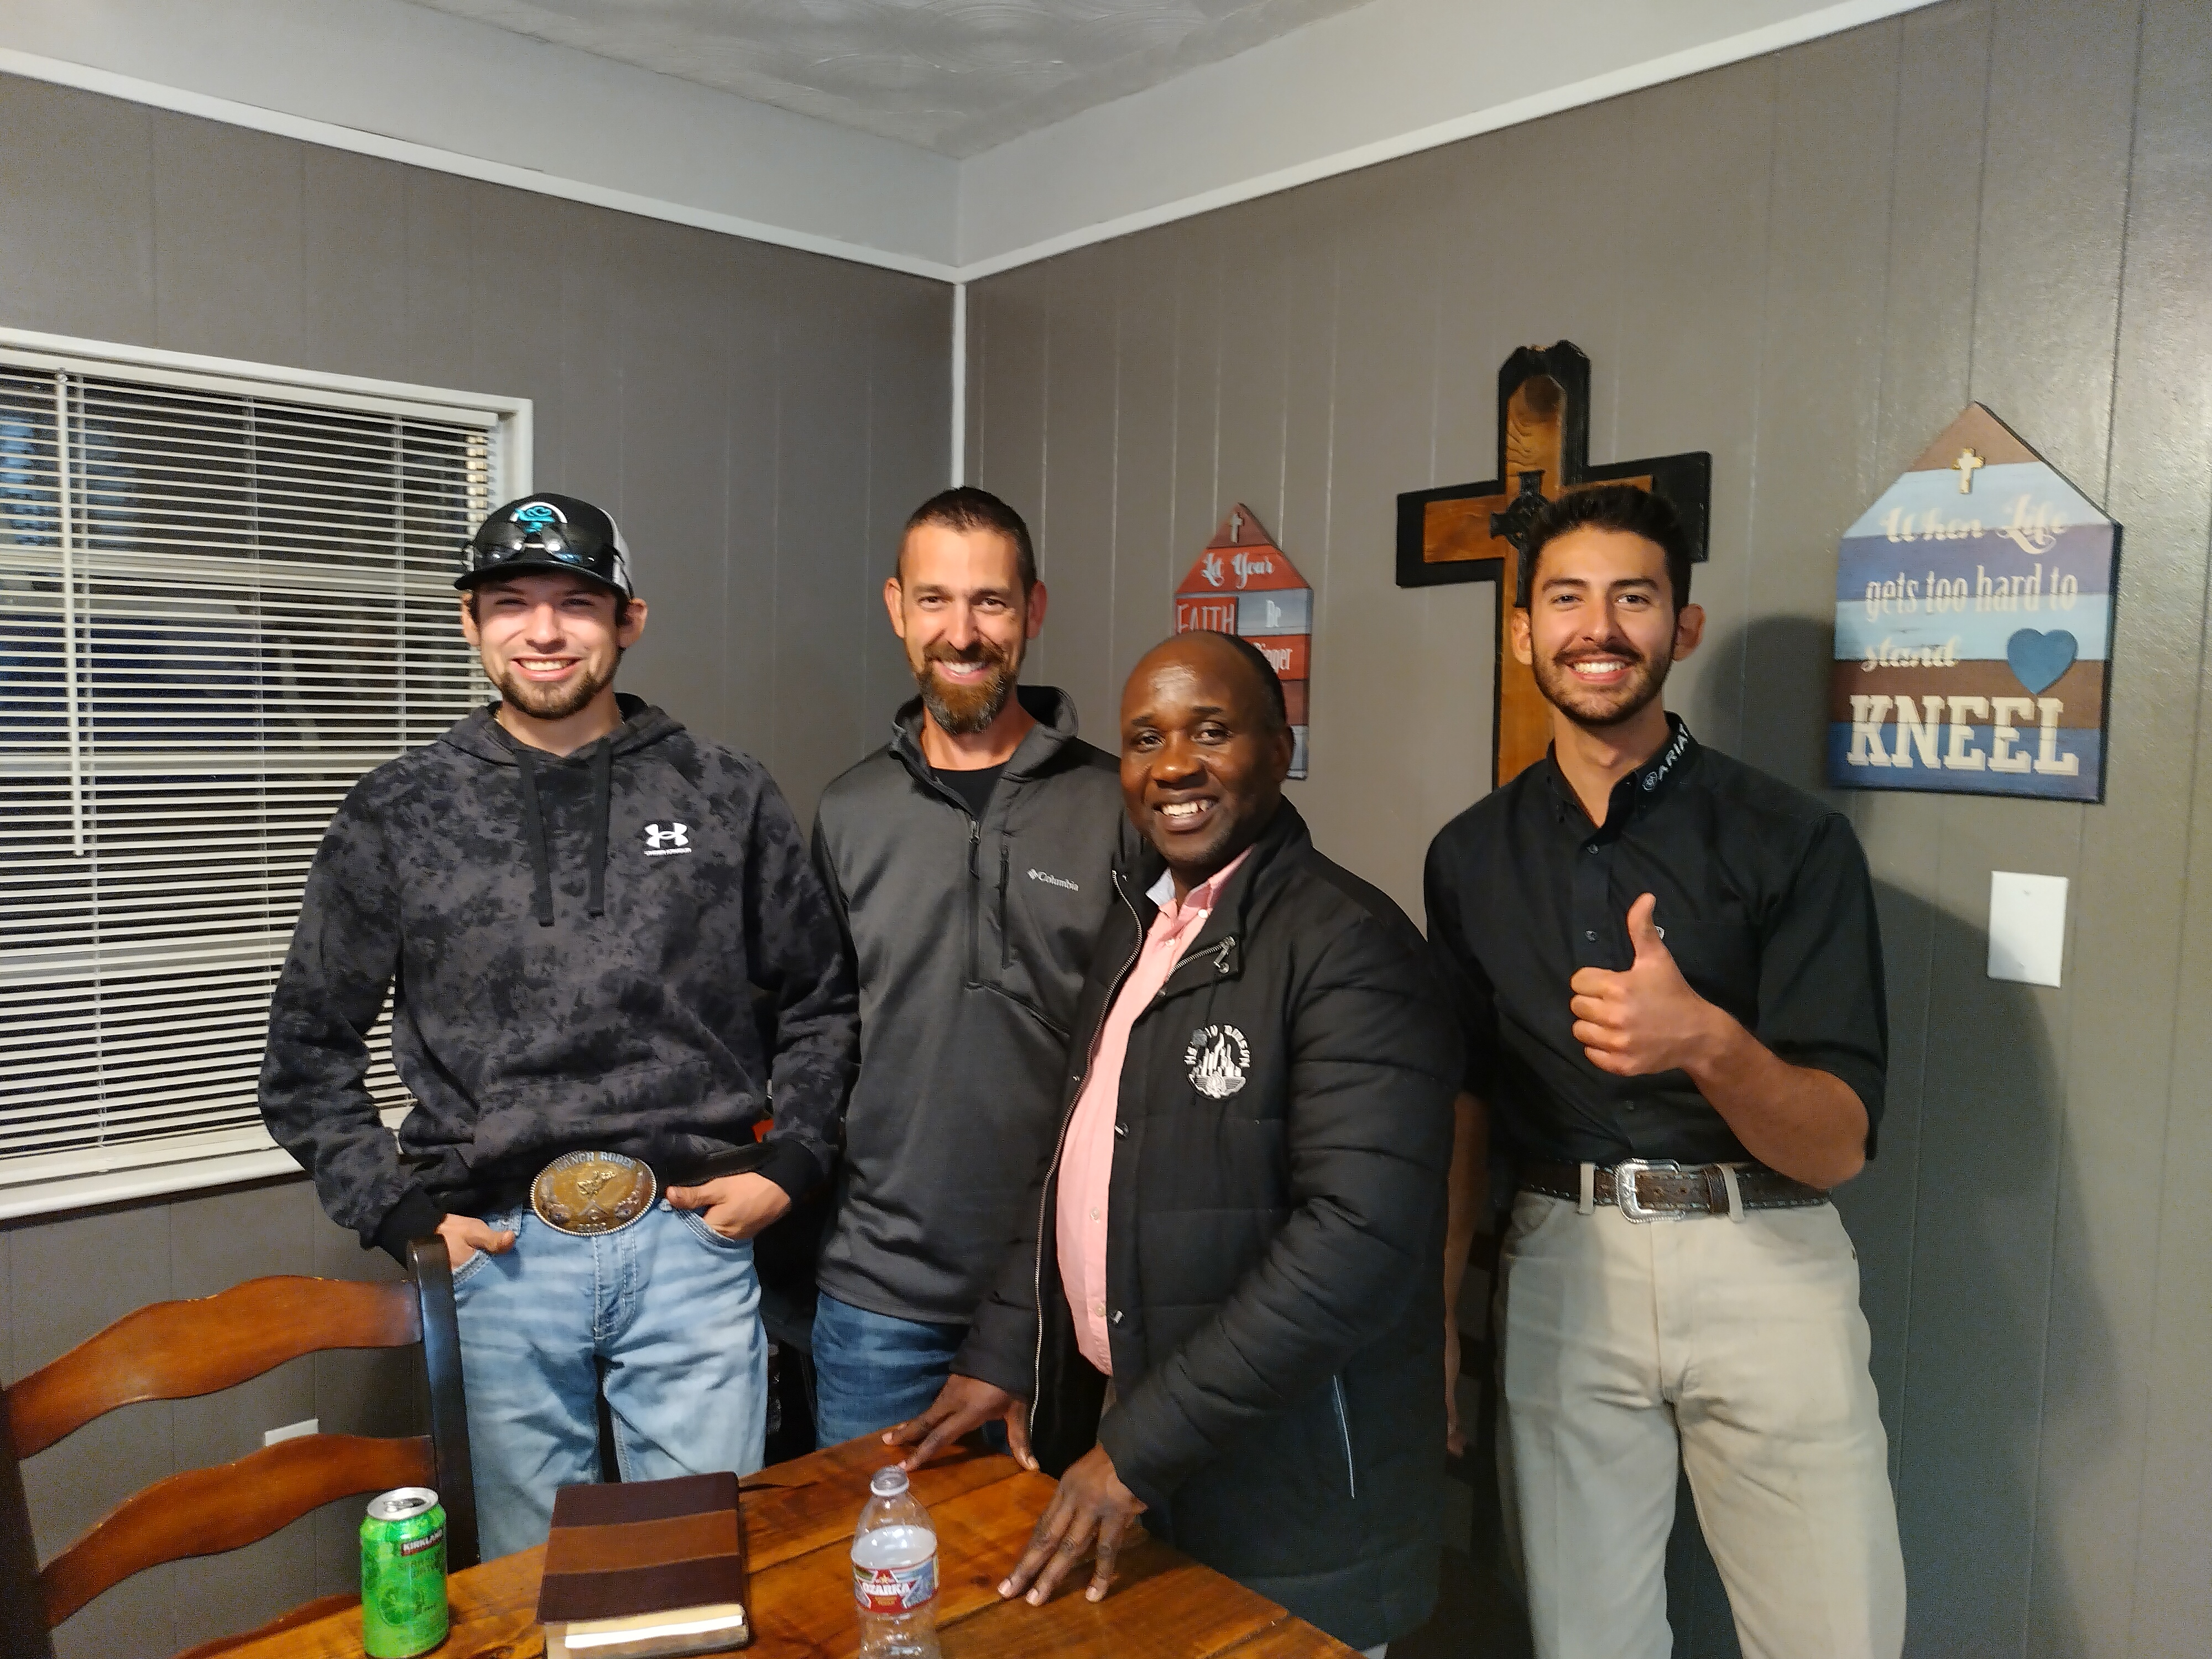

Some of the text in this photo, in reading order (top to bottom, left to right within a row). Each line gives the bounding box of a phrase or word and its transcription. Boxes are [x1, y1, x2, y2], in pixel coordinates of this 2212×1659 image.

[1880, 494, 2069, 554] When Life
[1201, 552, 1274, 589] Let Your
[1865, 562, 2079, 623] gets too hard to
[1177, 603, 1235, 635] FAITH
[1251, 642, 1293, 675] gger
[1860, 635, 1961, 673] stand
[1846, 694, 2079, 776] KNEEL
[1037, 871, 1079, 891] Columbia
